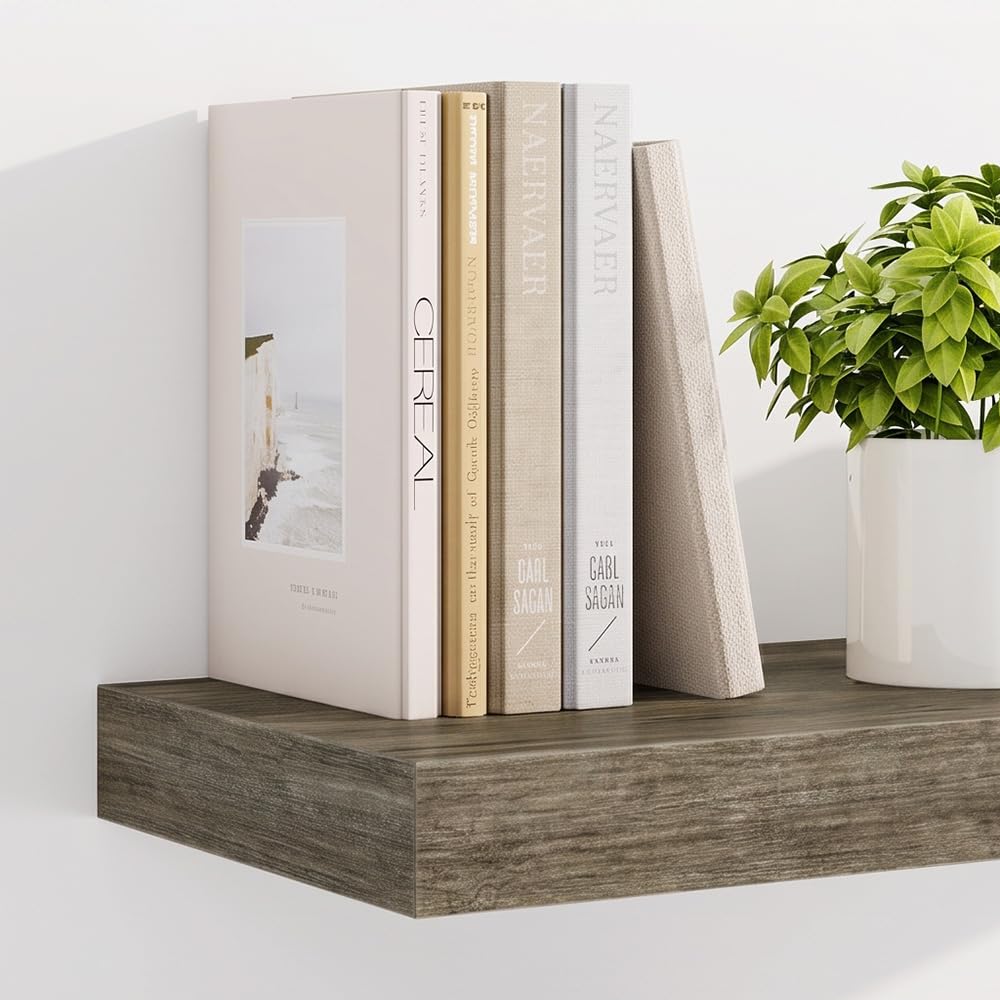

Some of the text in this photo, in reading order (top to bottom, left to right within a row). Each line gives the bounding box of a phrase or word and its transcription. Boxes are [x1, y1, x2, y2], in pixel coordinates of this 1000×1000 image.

[522, 103, 547, 296] NAERVAER
[593, 103, 618, 296] NAERVAER
[413, 297, 435, 511] CEREAL
[513, 586, 553, 615] SAGAN
[585, 584, 624, 611] SAGAN
